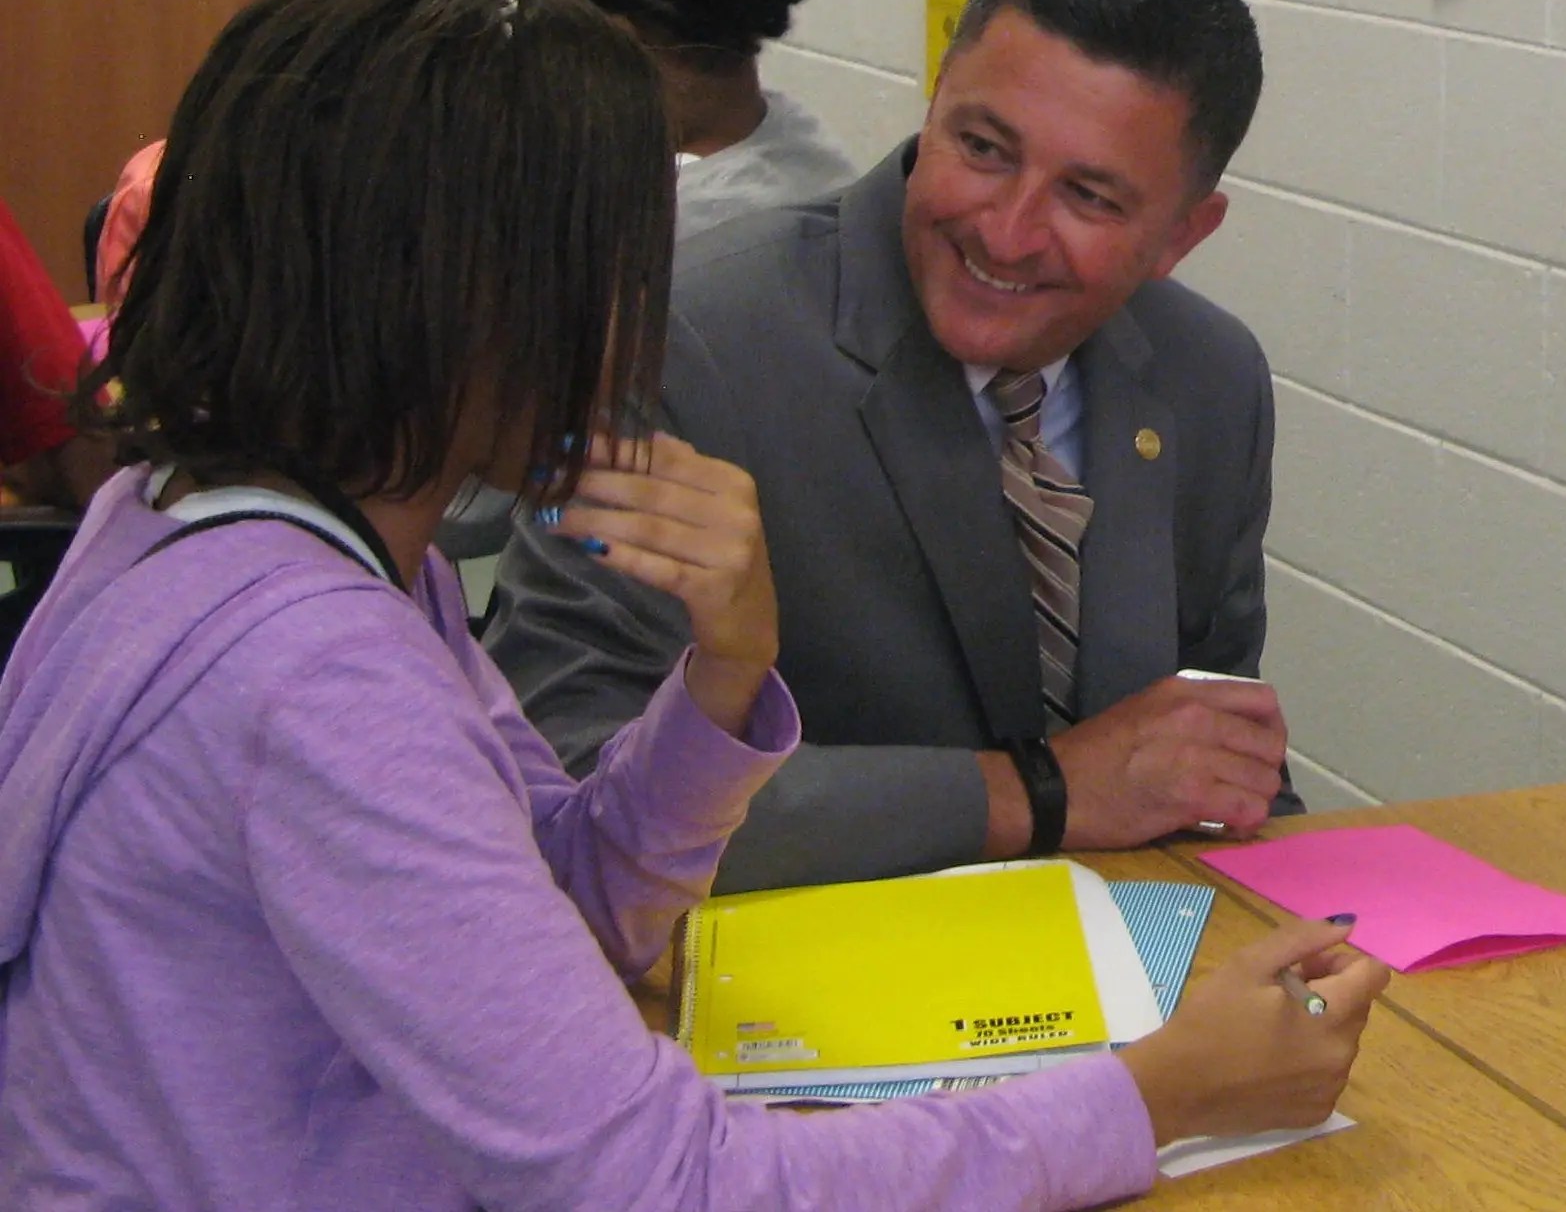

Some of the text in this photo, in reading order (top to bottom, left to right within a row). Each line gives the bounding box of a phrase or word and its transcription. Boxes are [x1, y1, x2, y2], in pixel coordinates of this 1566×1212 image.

[950, 1010, 1075, 1031] 1 SUBJECT
[968, 1030, 1069, 1048] WIDE RULED
[997, 1024, 1056, 1038] Sheets
